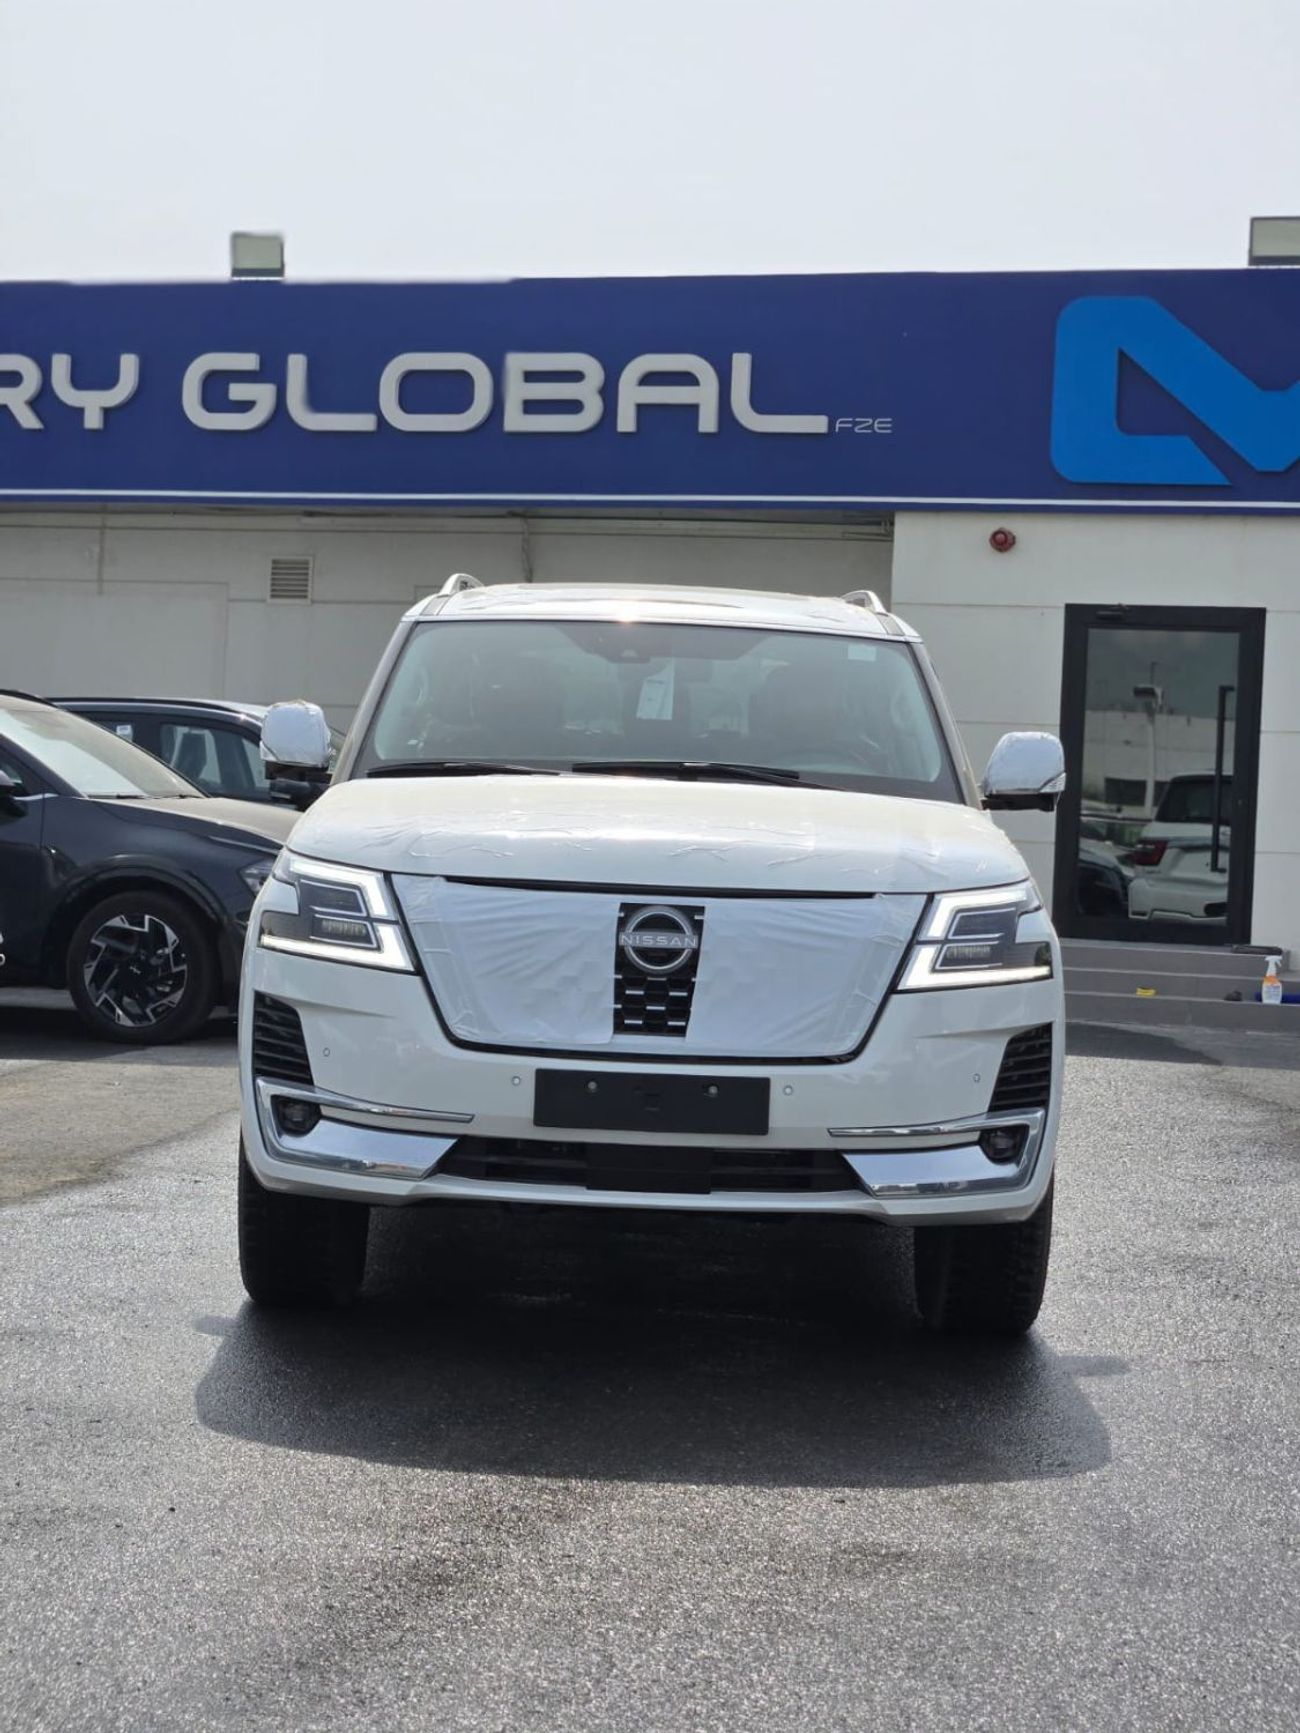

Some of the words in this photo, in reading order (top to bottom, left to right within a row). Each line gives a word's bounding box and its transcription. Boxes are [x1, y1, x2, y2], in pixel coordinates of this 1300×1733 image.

[182, 352, 829, 434] GLOBAL
[835, 417, 893, 434] FZE
[621, 934, 696, 947] NISSAN
